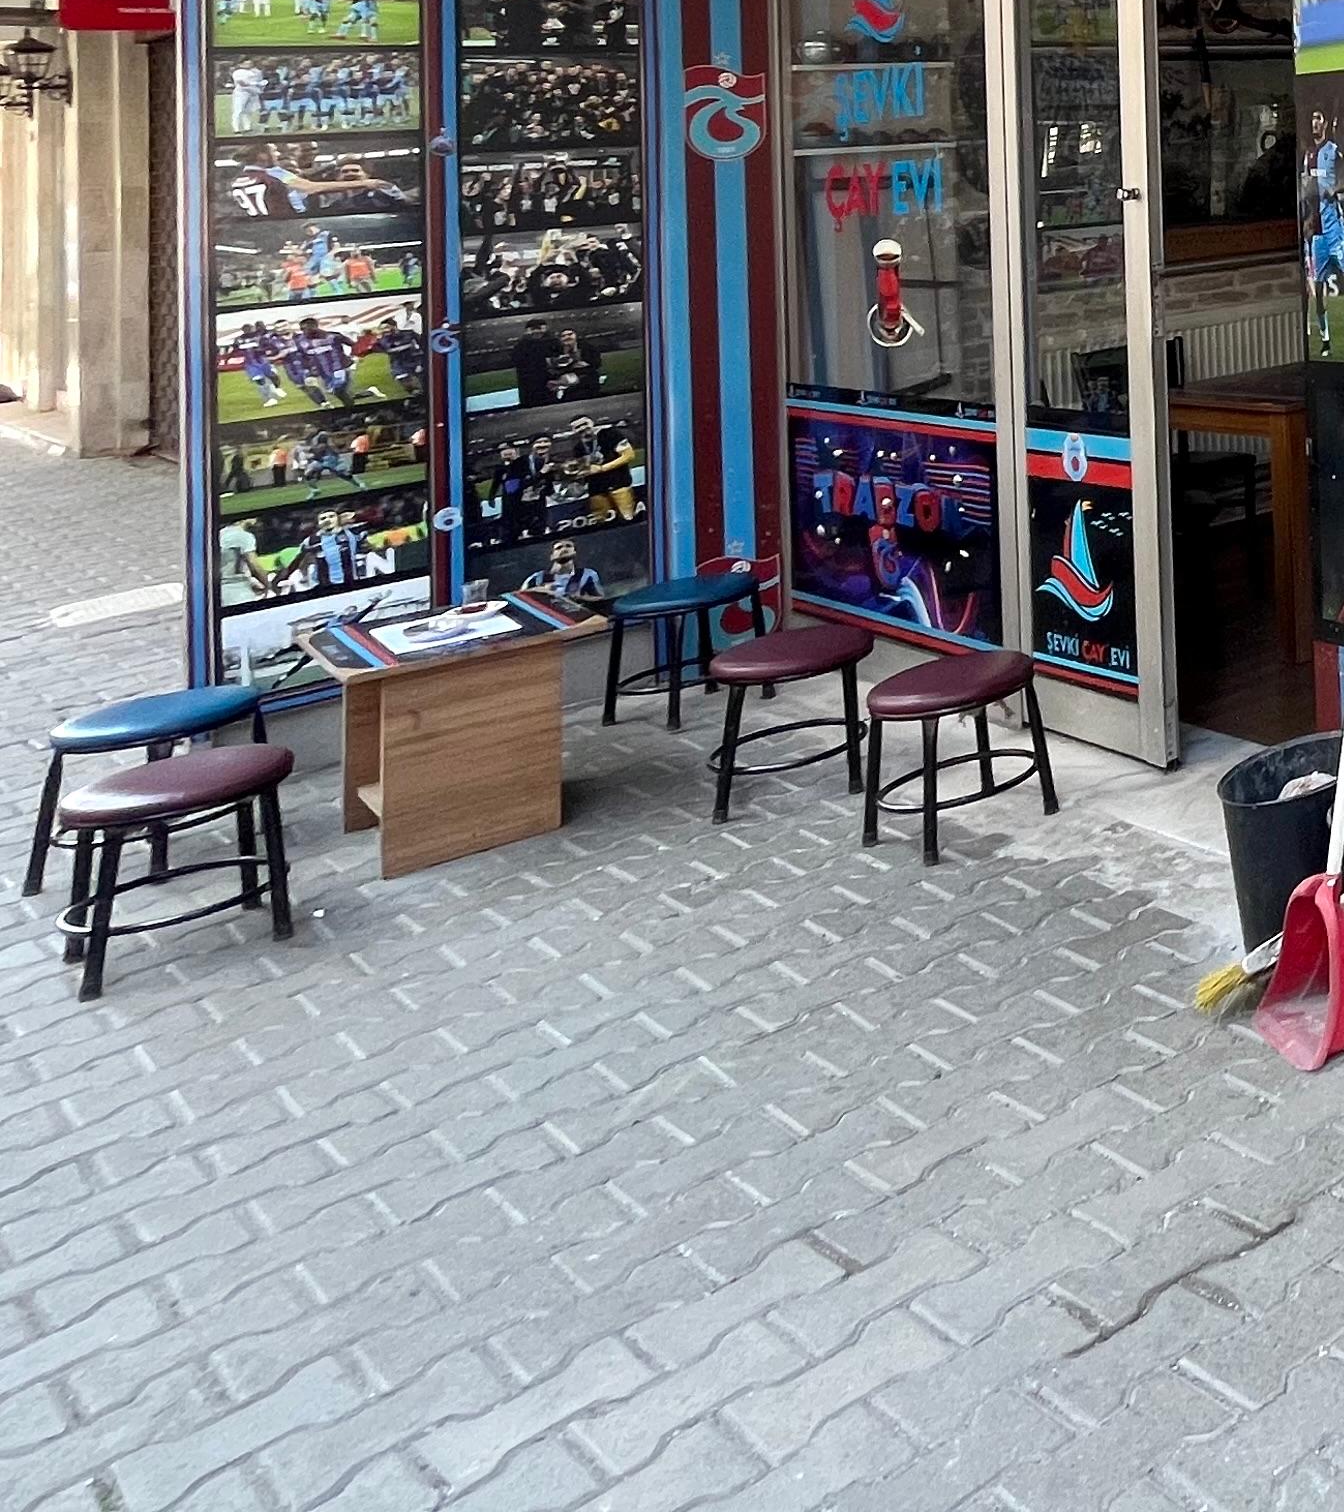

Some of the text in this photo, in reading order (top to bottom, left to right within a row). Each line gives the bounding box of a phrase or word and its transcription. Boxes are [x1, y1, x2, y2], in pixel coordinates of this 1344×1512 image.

[826, 159, 887, 233] ÇAY
[1046, 631, 1080, 656] ŞEVKİ
[1081, 639, 1105, 664] ÇAY
